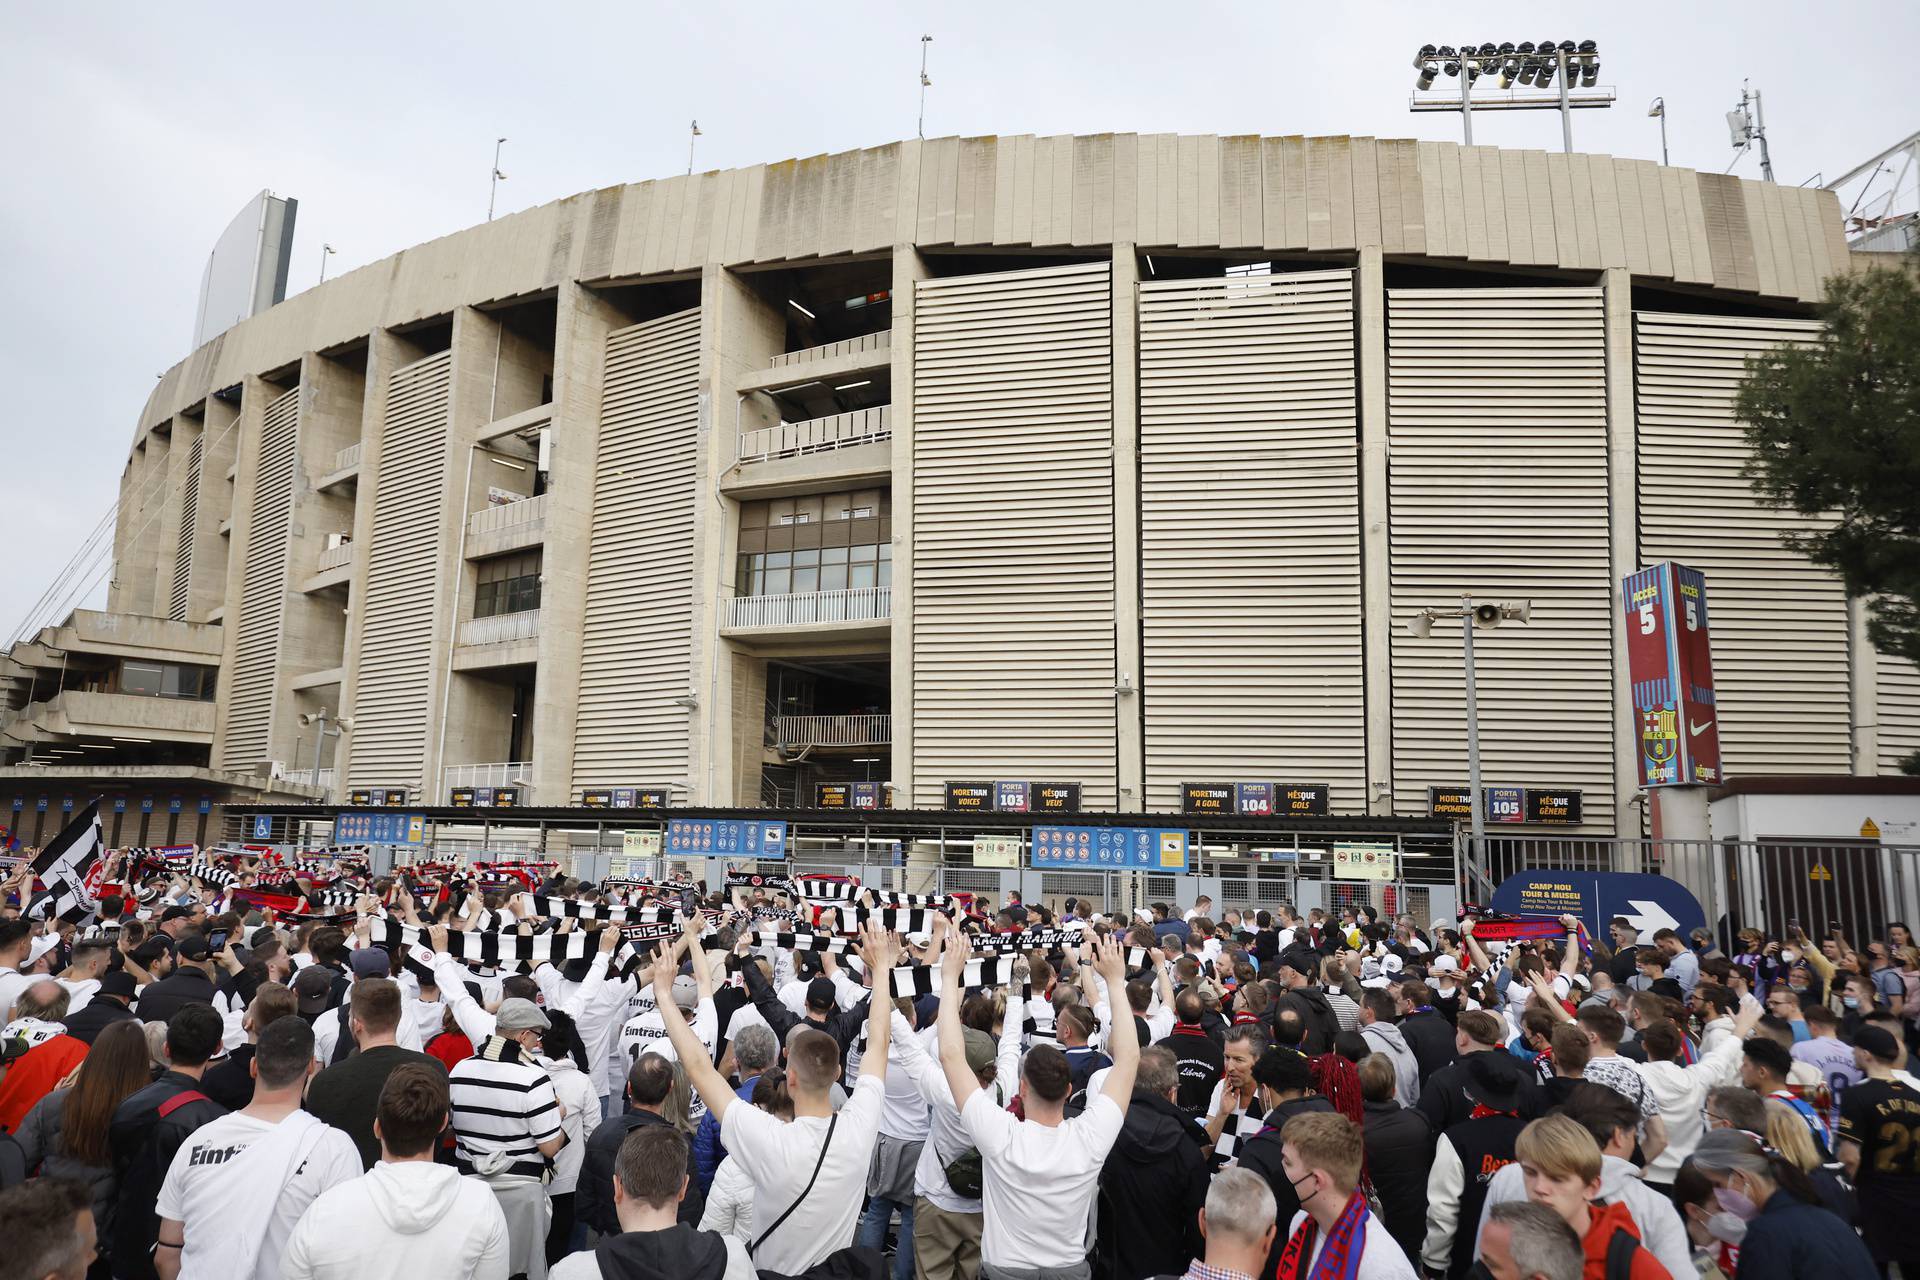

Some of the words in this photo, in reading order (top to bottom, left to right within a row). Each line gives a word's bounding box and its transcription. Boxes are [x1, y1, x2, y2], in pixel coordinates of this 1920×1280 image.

[1640, 602, 1656, 635] 5
[1686, 600, 1698, 632] 5
[953, 788, 988, 797] MORETHAN
[1190, 790, 1228, 798] MORETHAN
[856, 796, 873, 806] 102
[958, 798, 981, 806] VOICES
[1000, 794, 1024, 806] 103
[1046, 799, 1063, 807] VEUS
[1202, 799, 1220, 807] GOAL
[1439, 794, 1473, 803] MORETHA
[200, 800, 209, 808] 111
[1242, 799, 1268, 811] 104
[1291, 801, 1310, 809] GOLS
[1493, 802, 1519, 814] 105
[1529, 883, 1553, 891] CAMP
[1521, 890, 1544, 898] TOUR
[1551, 891, 1580, 900] MUSEU
[1179, 1067, 1206, 1080] Liberty
